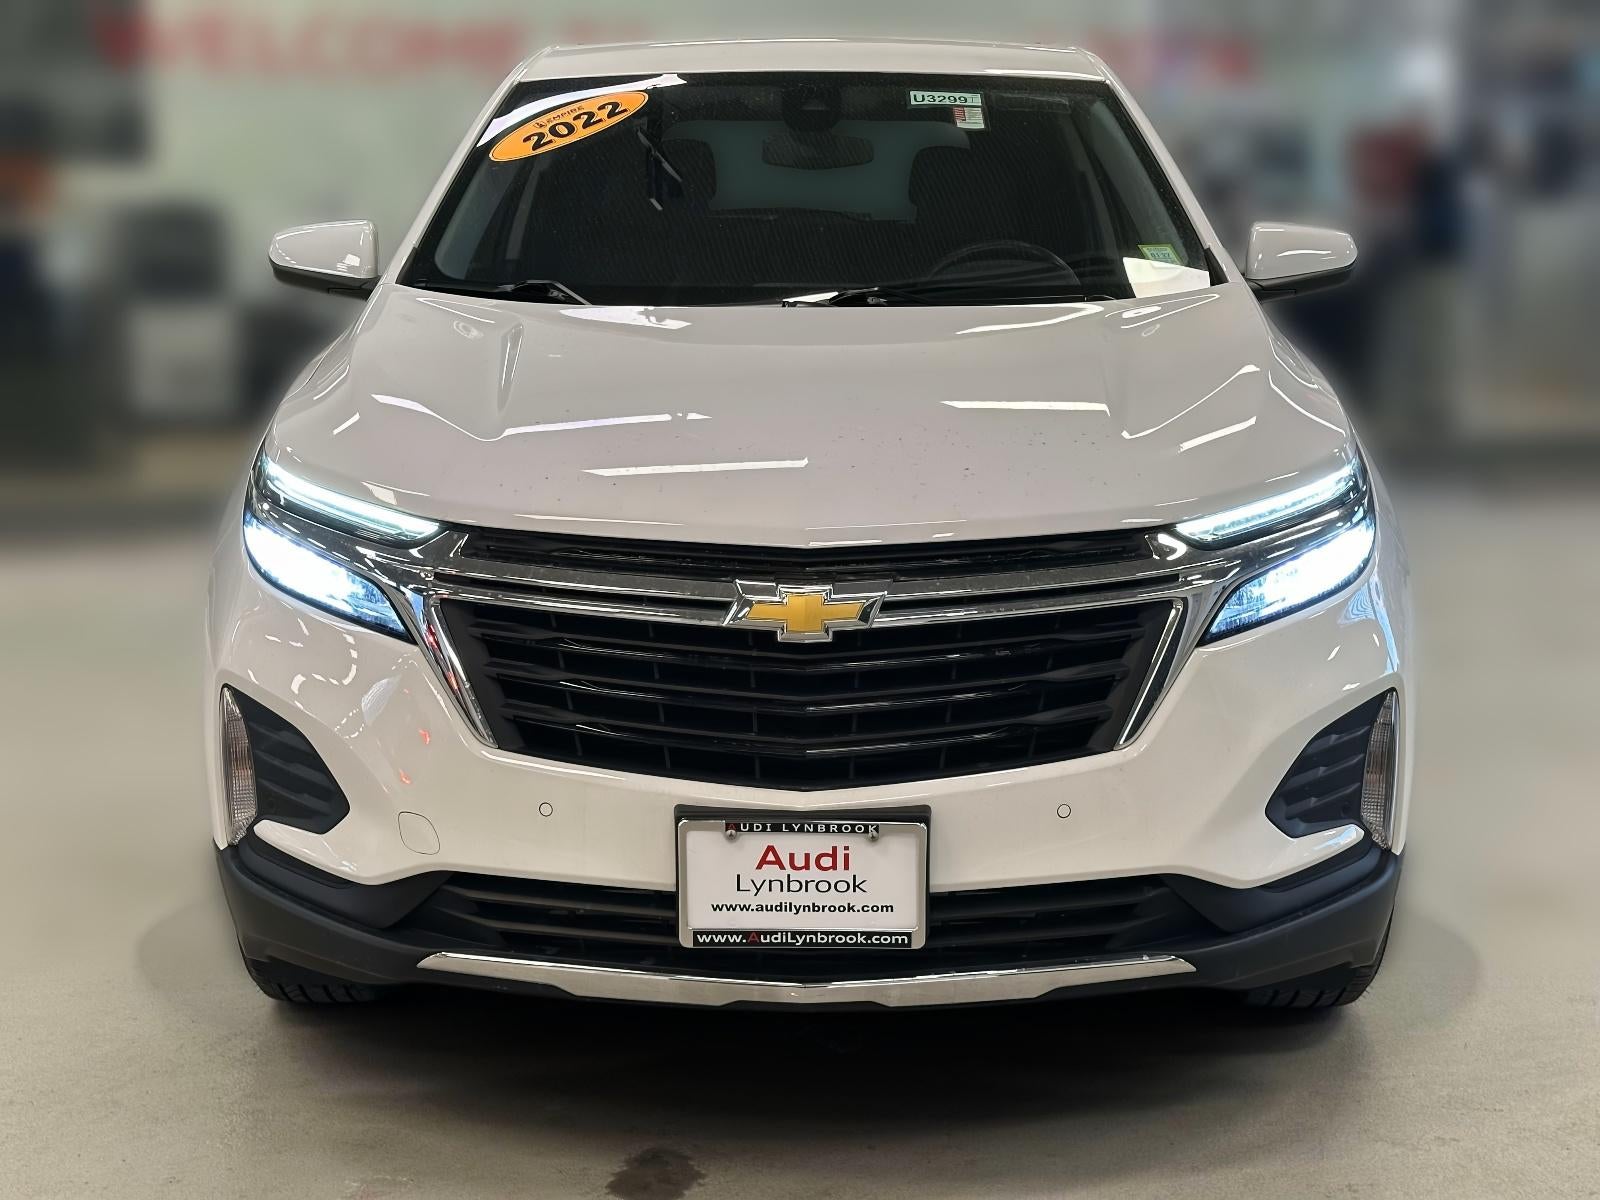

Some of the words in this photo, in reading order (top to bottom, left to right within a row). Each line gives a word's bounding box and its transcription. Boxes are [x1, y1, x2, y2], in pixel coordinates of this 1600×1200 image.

[522, 101, 628, 151] 2022
[728, 823, 772, 832] AUDI
[782, 824, 880, 833] LYNBROOK
[755, 844, 850, 871] Audi
[736, 874, 867, 896] Lynbrook
[711, 902, 894, 914] www.audilynbrook.com
[697, 931, 908, 945] www.AudiLynbrook.com
